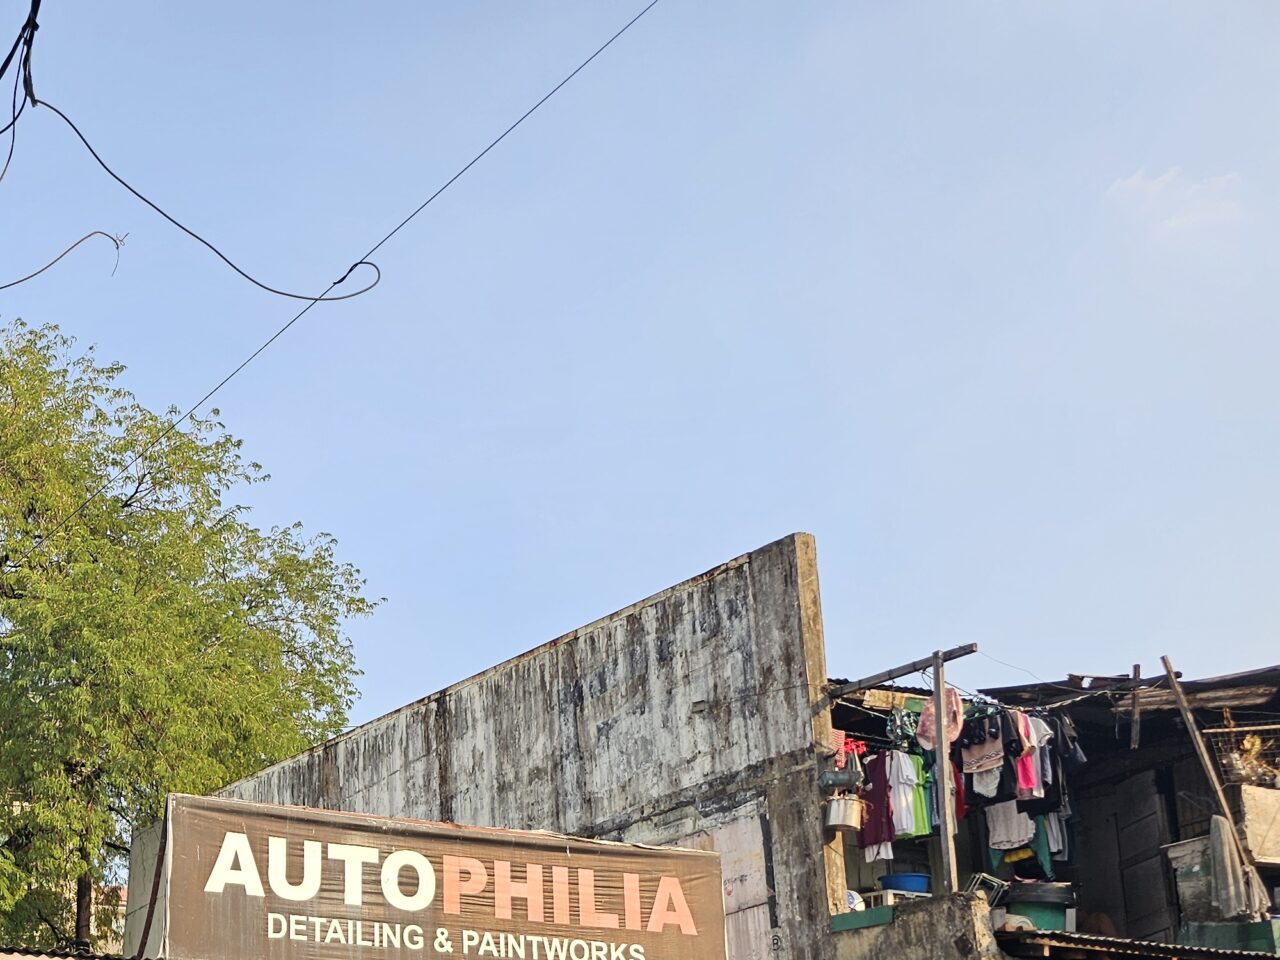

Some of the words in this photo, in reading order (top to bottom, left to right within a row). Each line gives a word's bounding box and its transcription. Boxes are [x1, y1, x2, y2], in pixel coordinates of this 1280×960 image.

[204, 832, 698, 936] AUTOPHILIA
[267, 912, 424, 950] DETAILING
[433, 927, 454, 954] &
